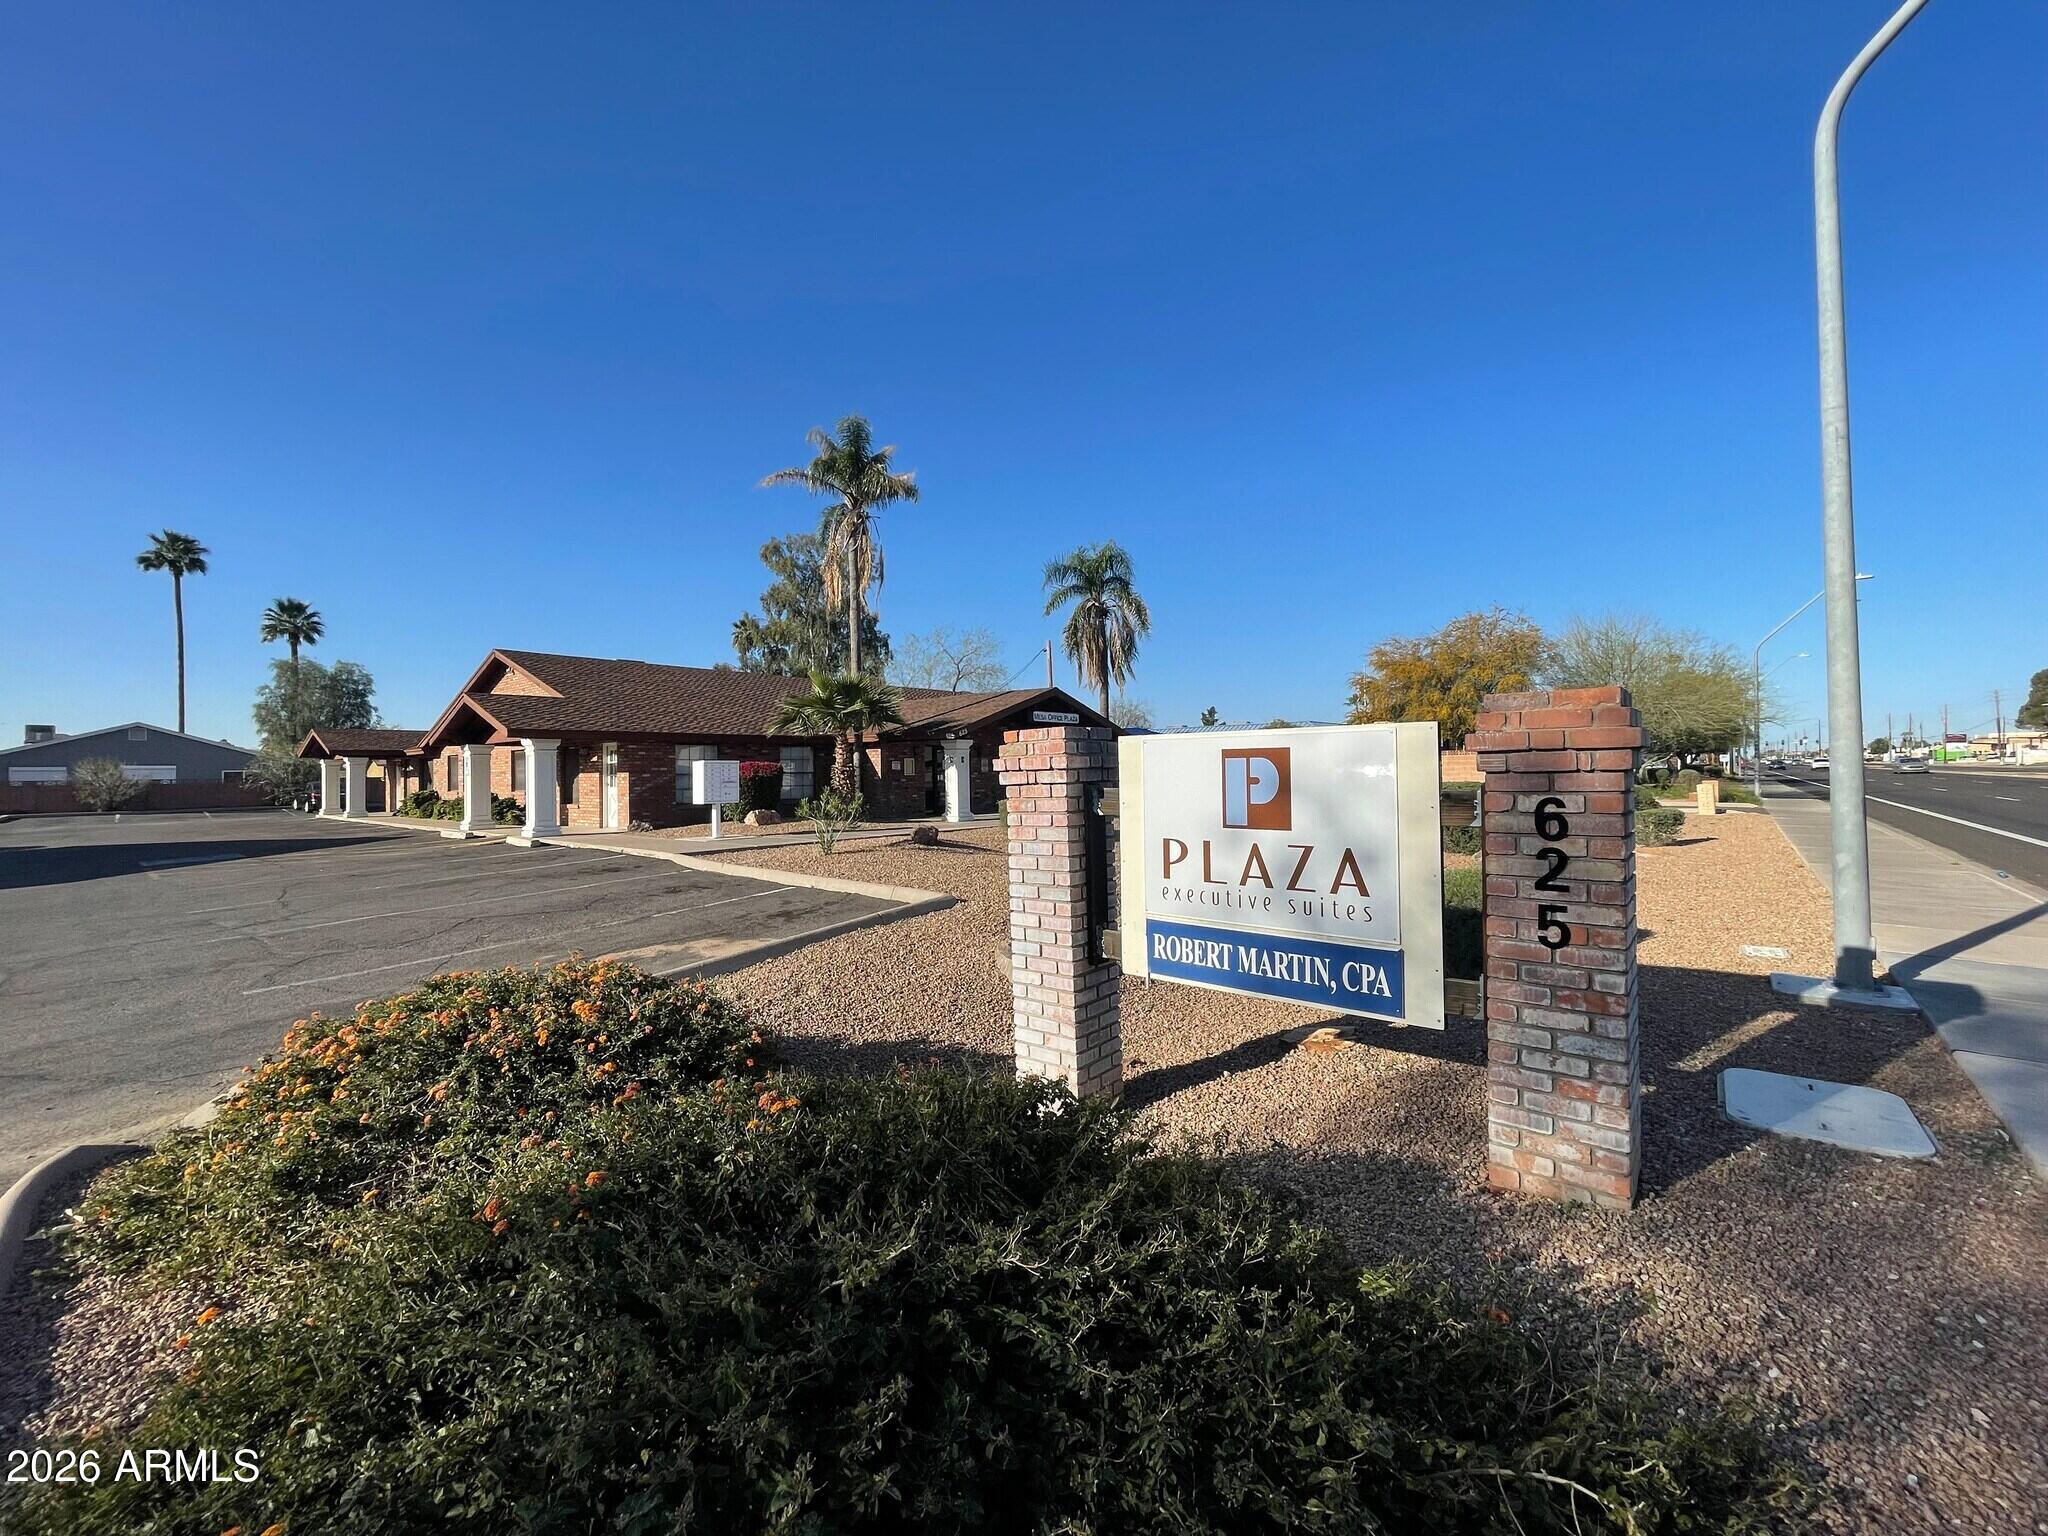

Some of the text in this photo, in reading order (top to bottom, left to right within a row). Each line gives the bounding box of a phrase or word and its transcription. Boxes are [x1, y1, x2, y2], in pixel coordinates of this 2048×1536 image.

[1162, 838, 1371, 898] PLAZA
[1534, 796, 1572, 950] 625
[1162, 886, 1373, 923] executive suites
[1153, 933, 1393, 998] ROBERT MARTIN, CPA
